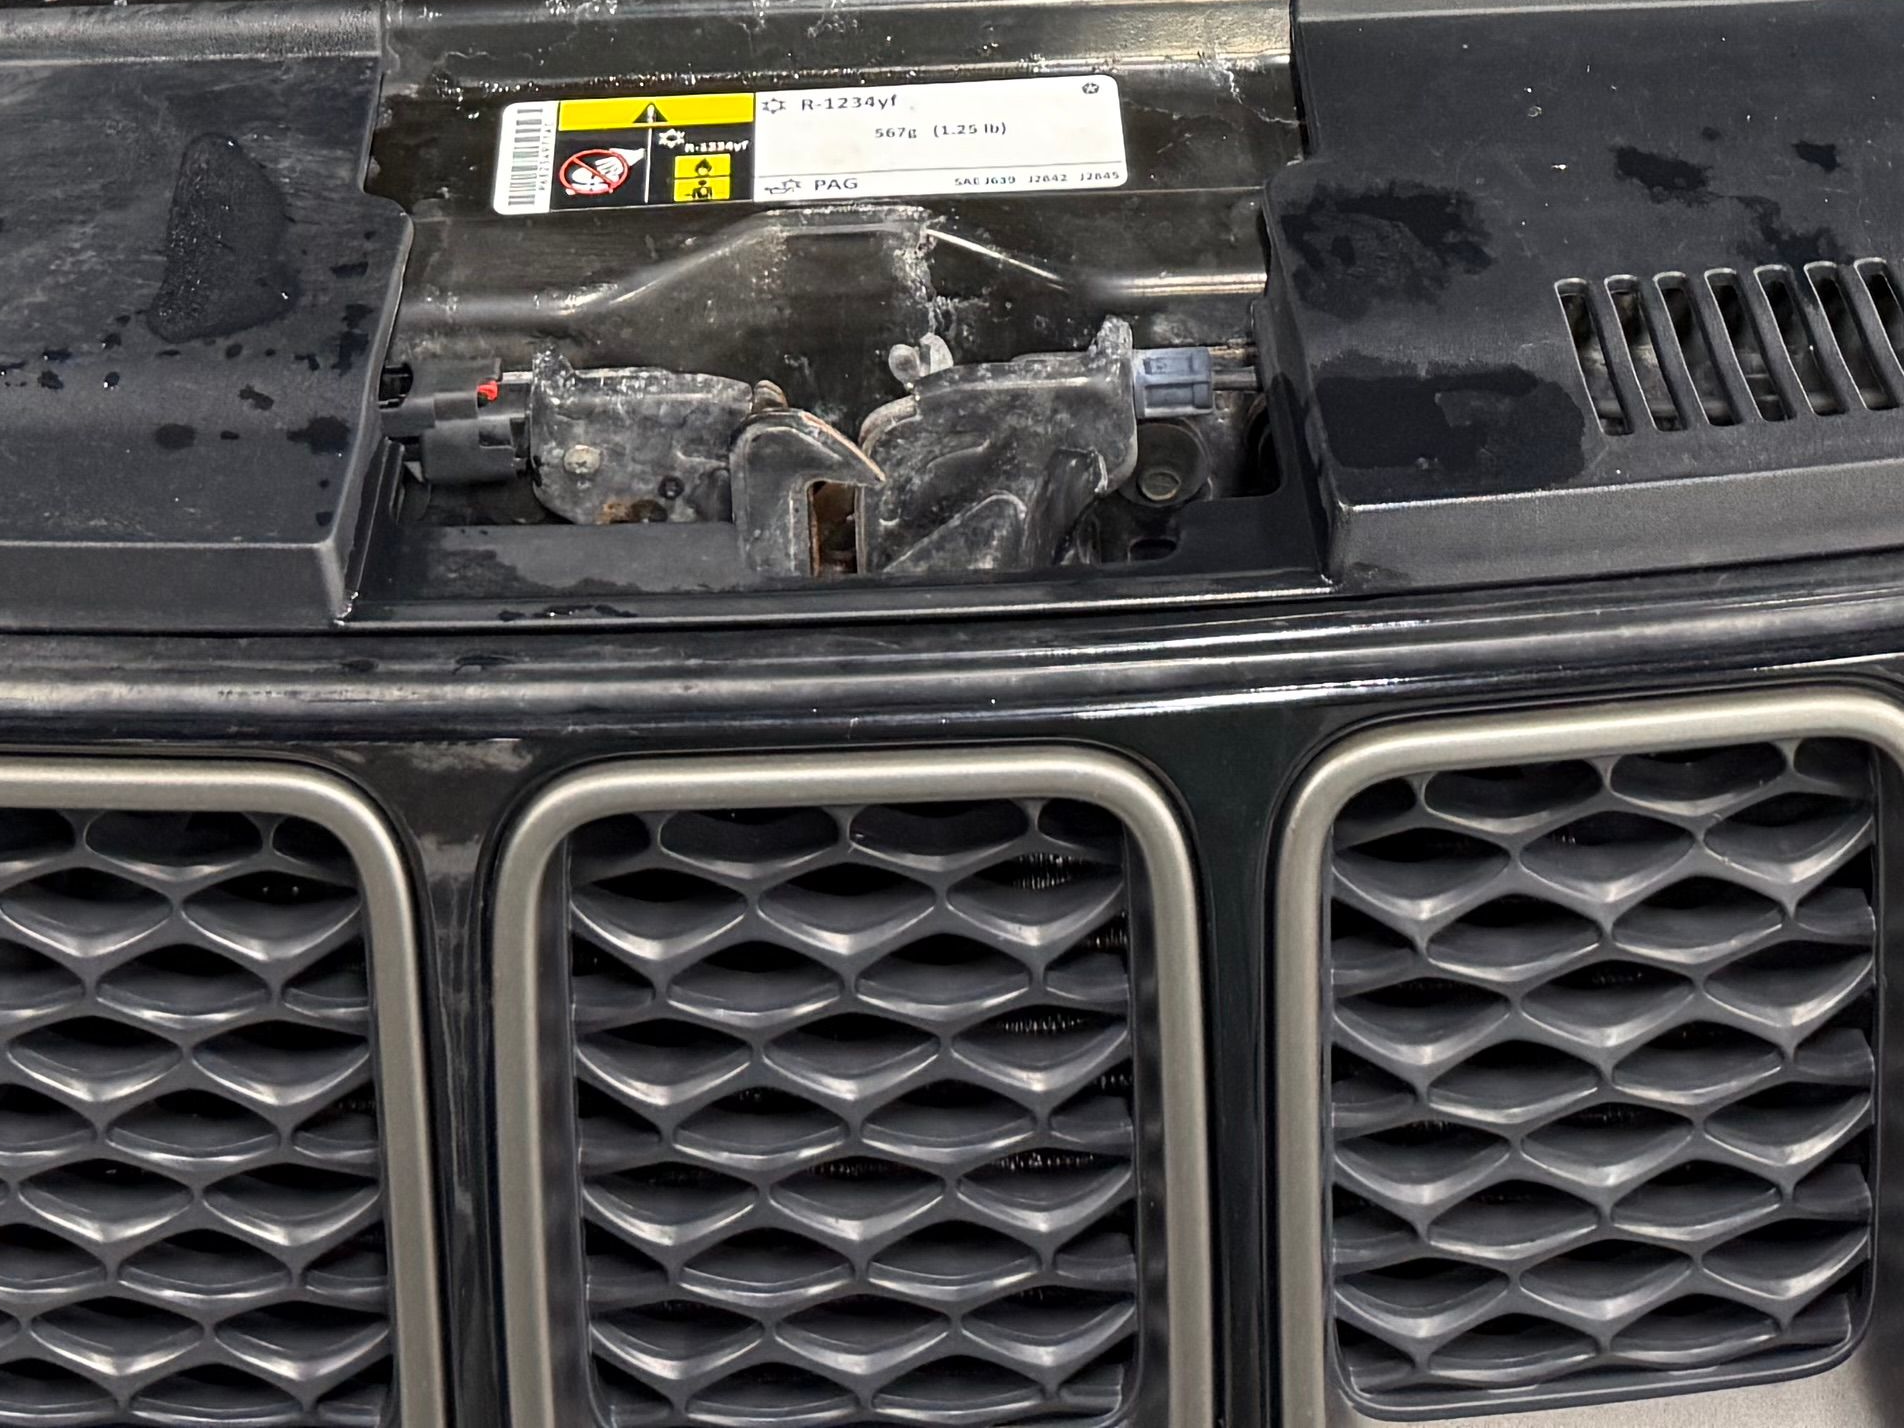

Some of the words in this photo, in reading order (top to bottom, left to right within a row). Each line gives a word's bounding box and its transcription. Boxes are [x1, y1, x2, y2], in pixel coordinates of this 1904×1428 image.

[801, 95, 898, 111] R-1234yf
[874, 127, 918, 140] 567g
[932, 125, 977, 138] (1.25
[983, 122, 1008, 136] lb)
[814, 178, 859, 191] PAG
